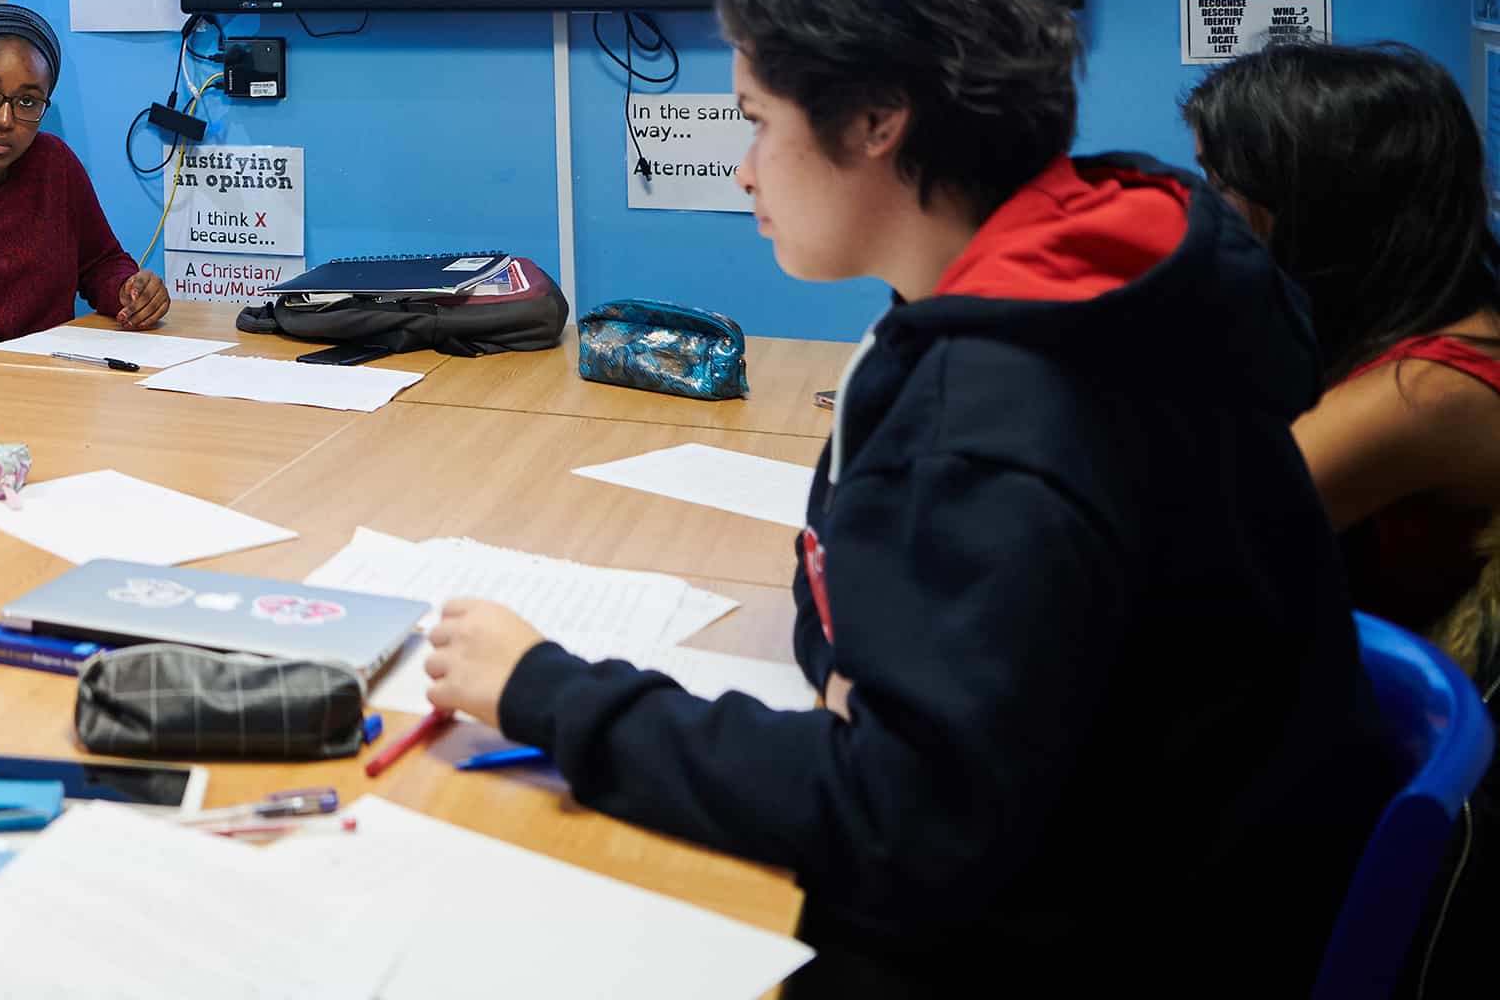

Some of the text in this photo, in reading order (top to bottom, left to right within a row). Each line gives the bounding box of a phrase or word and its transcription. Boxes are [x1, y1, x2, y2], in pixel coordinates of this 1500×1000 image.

[1202, 8, 1243, 16] DESCRIBE
[1204, 18, 1242, 26] IDENTIFY
[1208, 36, 1238, 44] LOCATE
[1214, 45, 1232, 53] LIST
[634, 104, 742, 120] In the sam
[634, 126, 691, 141] way...
[175, 173, 292, 192] an opinion
[197, 212, 266, 227] I think X
[191, 228, 275, 245] because...
[186, 263, 281, 281] A Christian/
